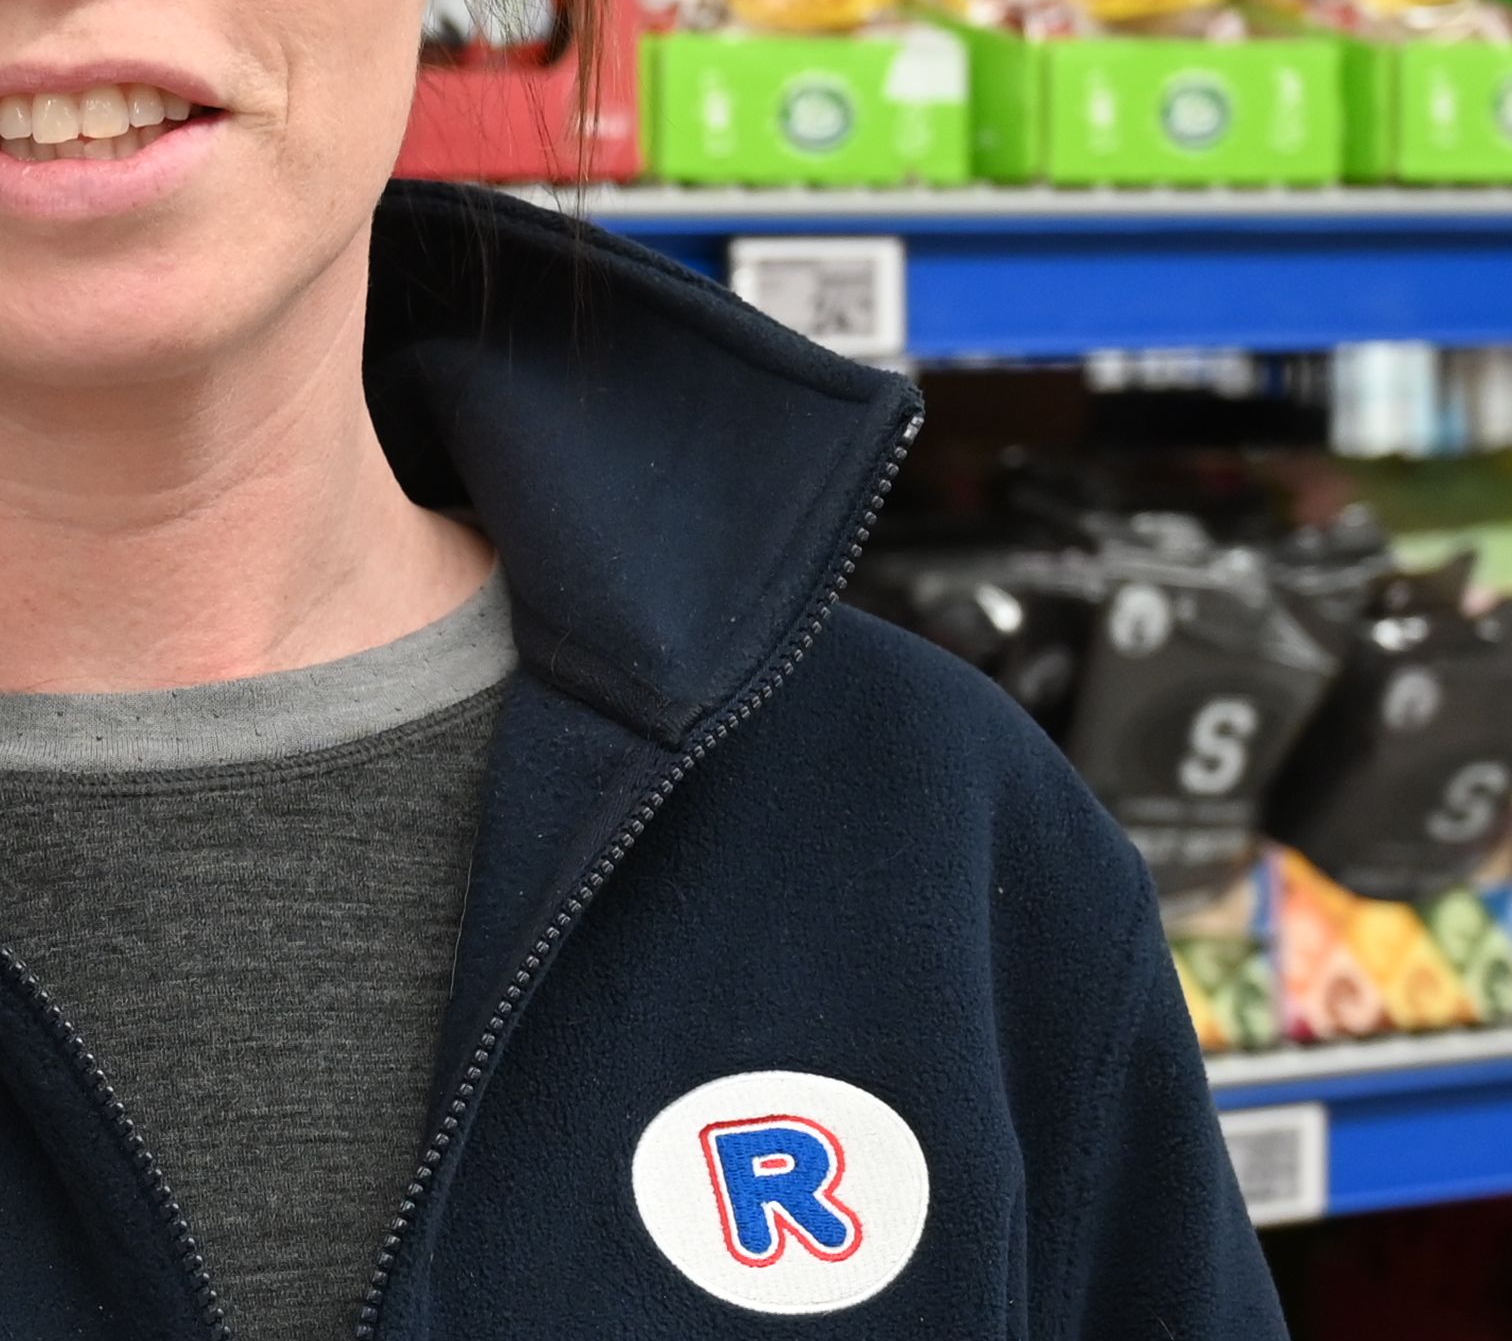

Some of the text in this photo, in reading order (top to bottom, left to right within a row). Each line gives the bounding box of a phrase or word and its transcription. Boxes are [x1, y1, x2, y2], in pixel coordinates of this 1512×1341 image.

[1180, 695, 1259, 795] S
[1425, 762, 1511, 843] S
[699, 1114, 863, 1268] R
